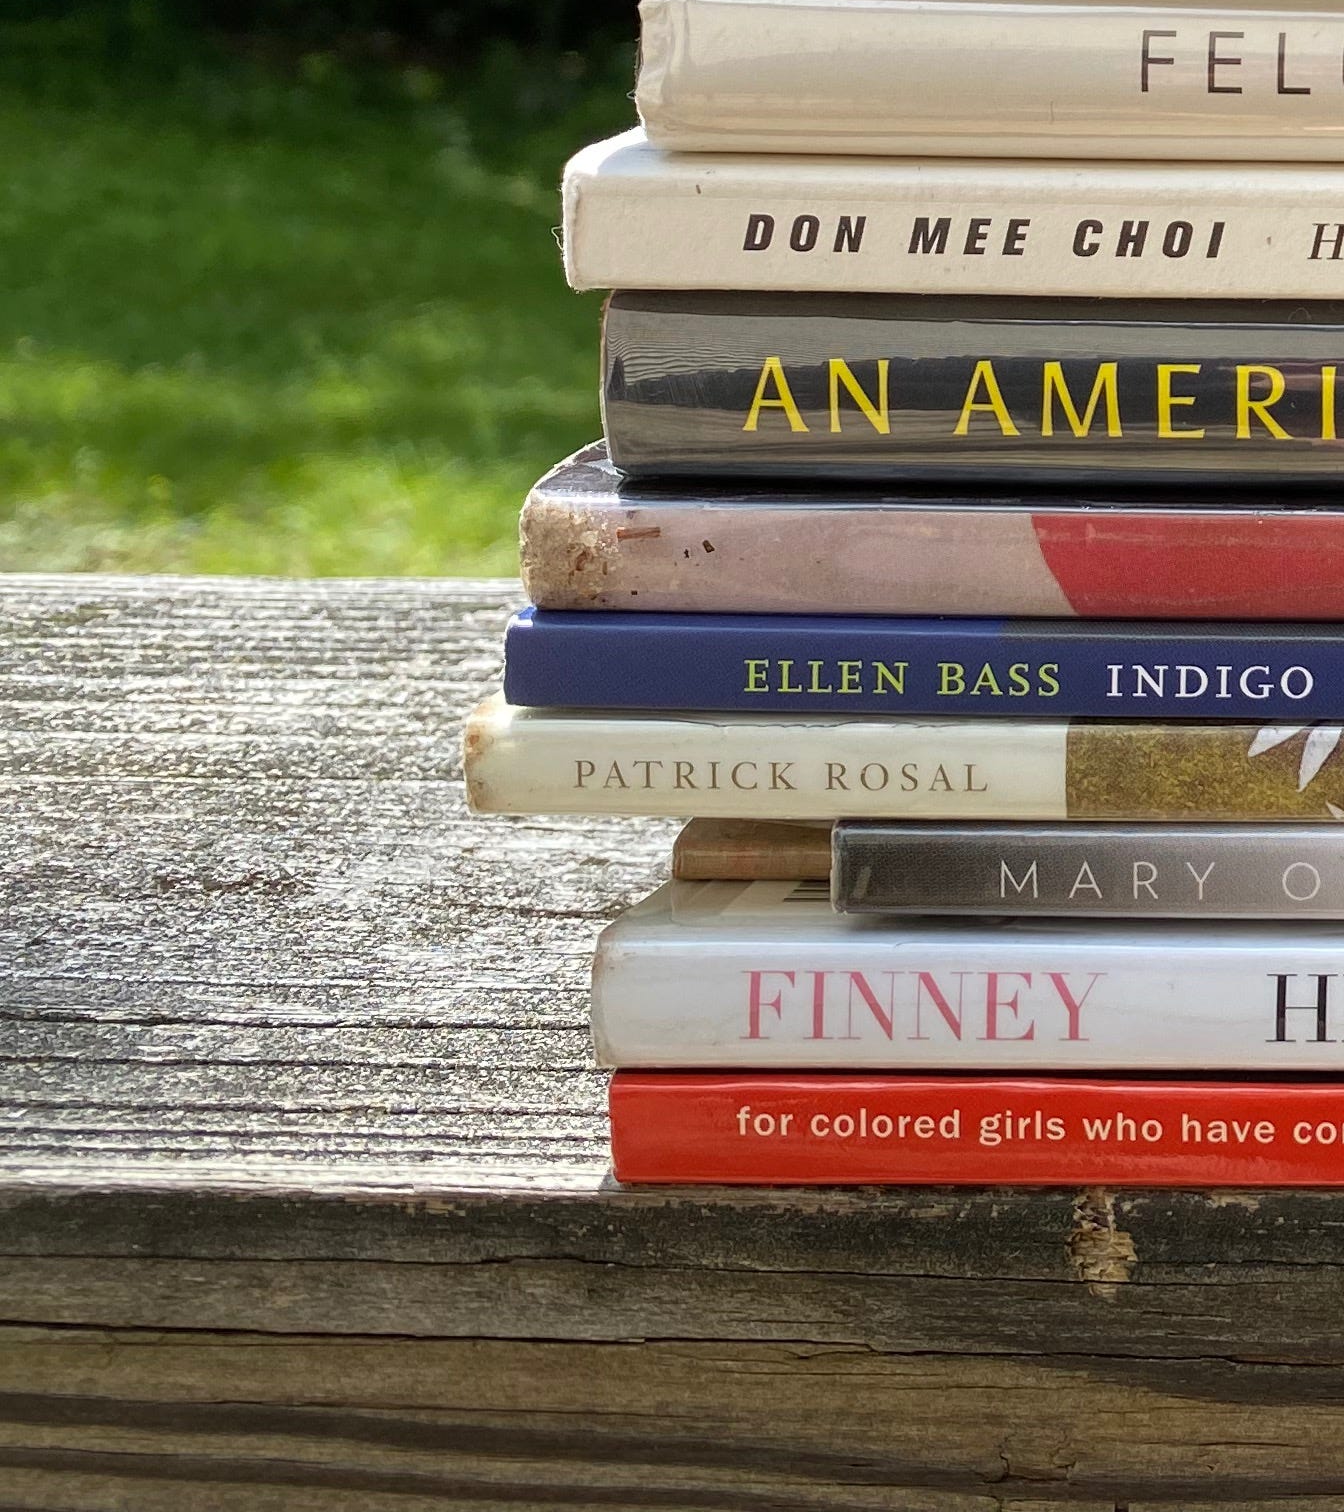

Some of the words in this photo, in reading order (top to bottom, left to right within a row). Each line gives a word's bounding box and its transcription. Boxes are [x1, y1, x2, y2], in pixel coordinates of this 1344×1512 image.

[743, 213, 867, 254] DON
[909, 216, 1028, 256] MEE
[1073, 219, 1226, 260] CHOI
[742, 357, 890, 435] AN
[744, 658, 910, 697] ELLEN
[936, 662, 1062, 699] BASS
[1106, 663, 1314, 701] INDIGO
[573, 758, 799, 792] PATRICK
[824, 760, 990, 793] ROSAL
[998, 862, 1219, 903] MARY
[738, 969, 1109, 1042] FINNEY
[736, 1106, 794, 1137] for
[811, 1108, 962, 1140] colored
[978, 1108, 1067, 1148] girls
[1082, 1111, 1165, 1143] who
[1181, 1113, 1277, 1145] have
